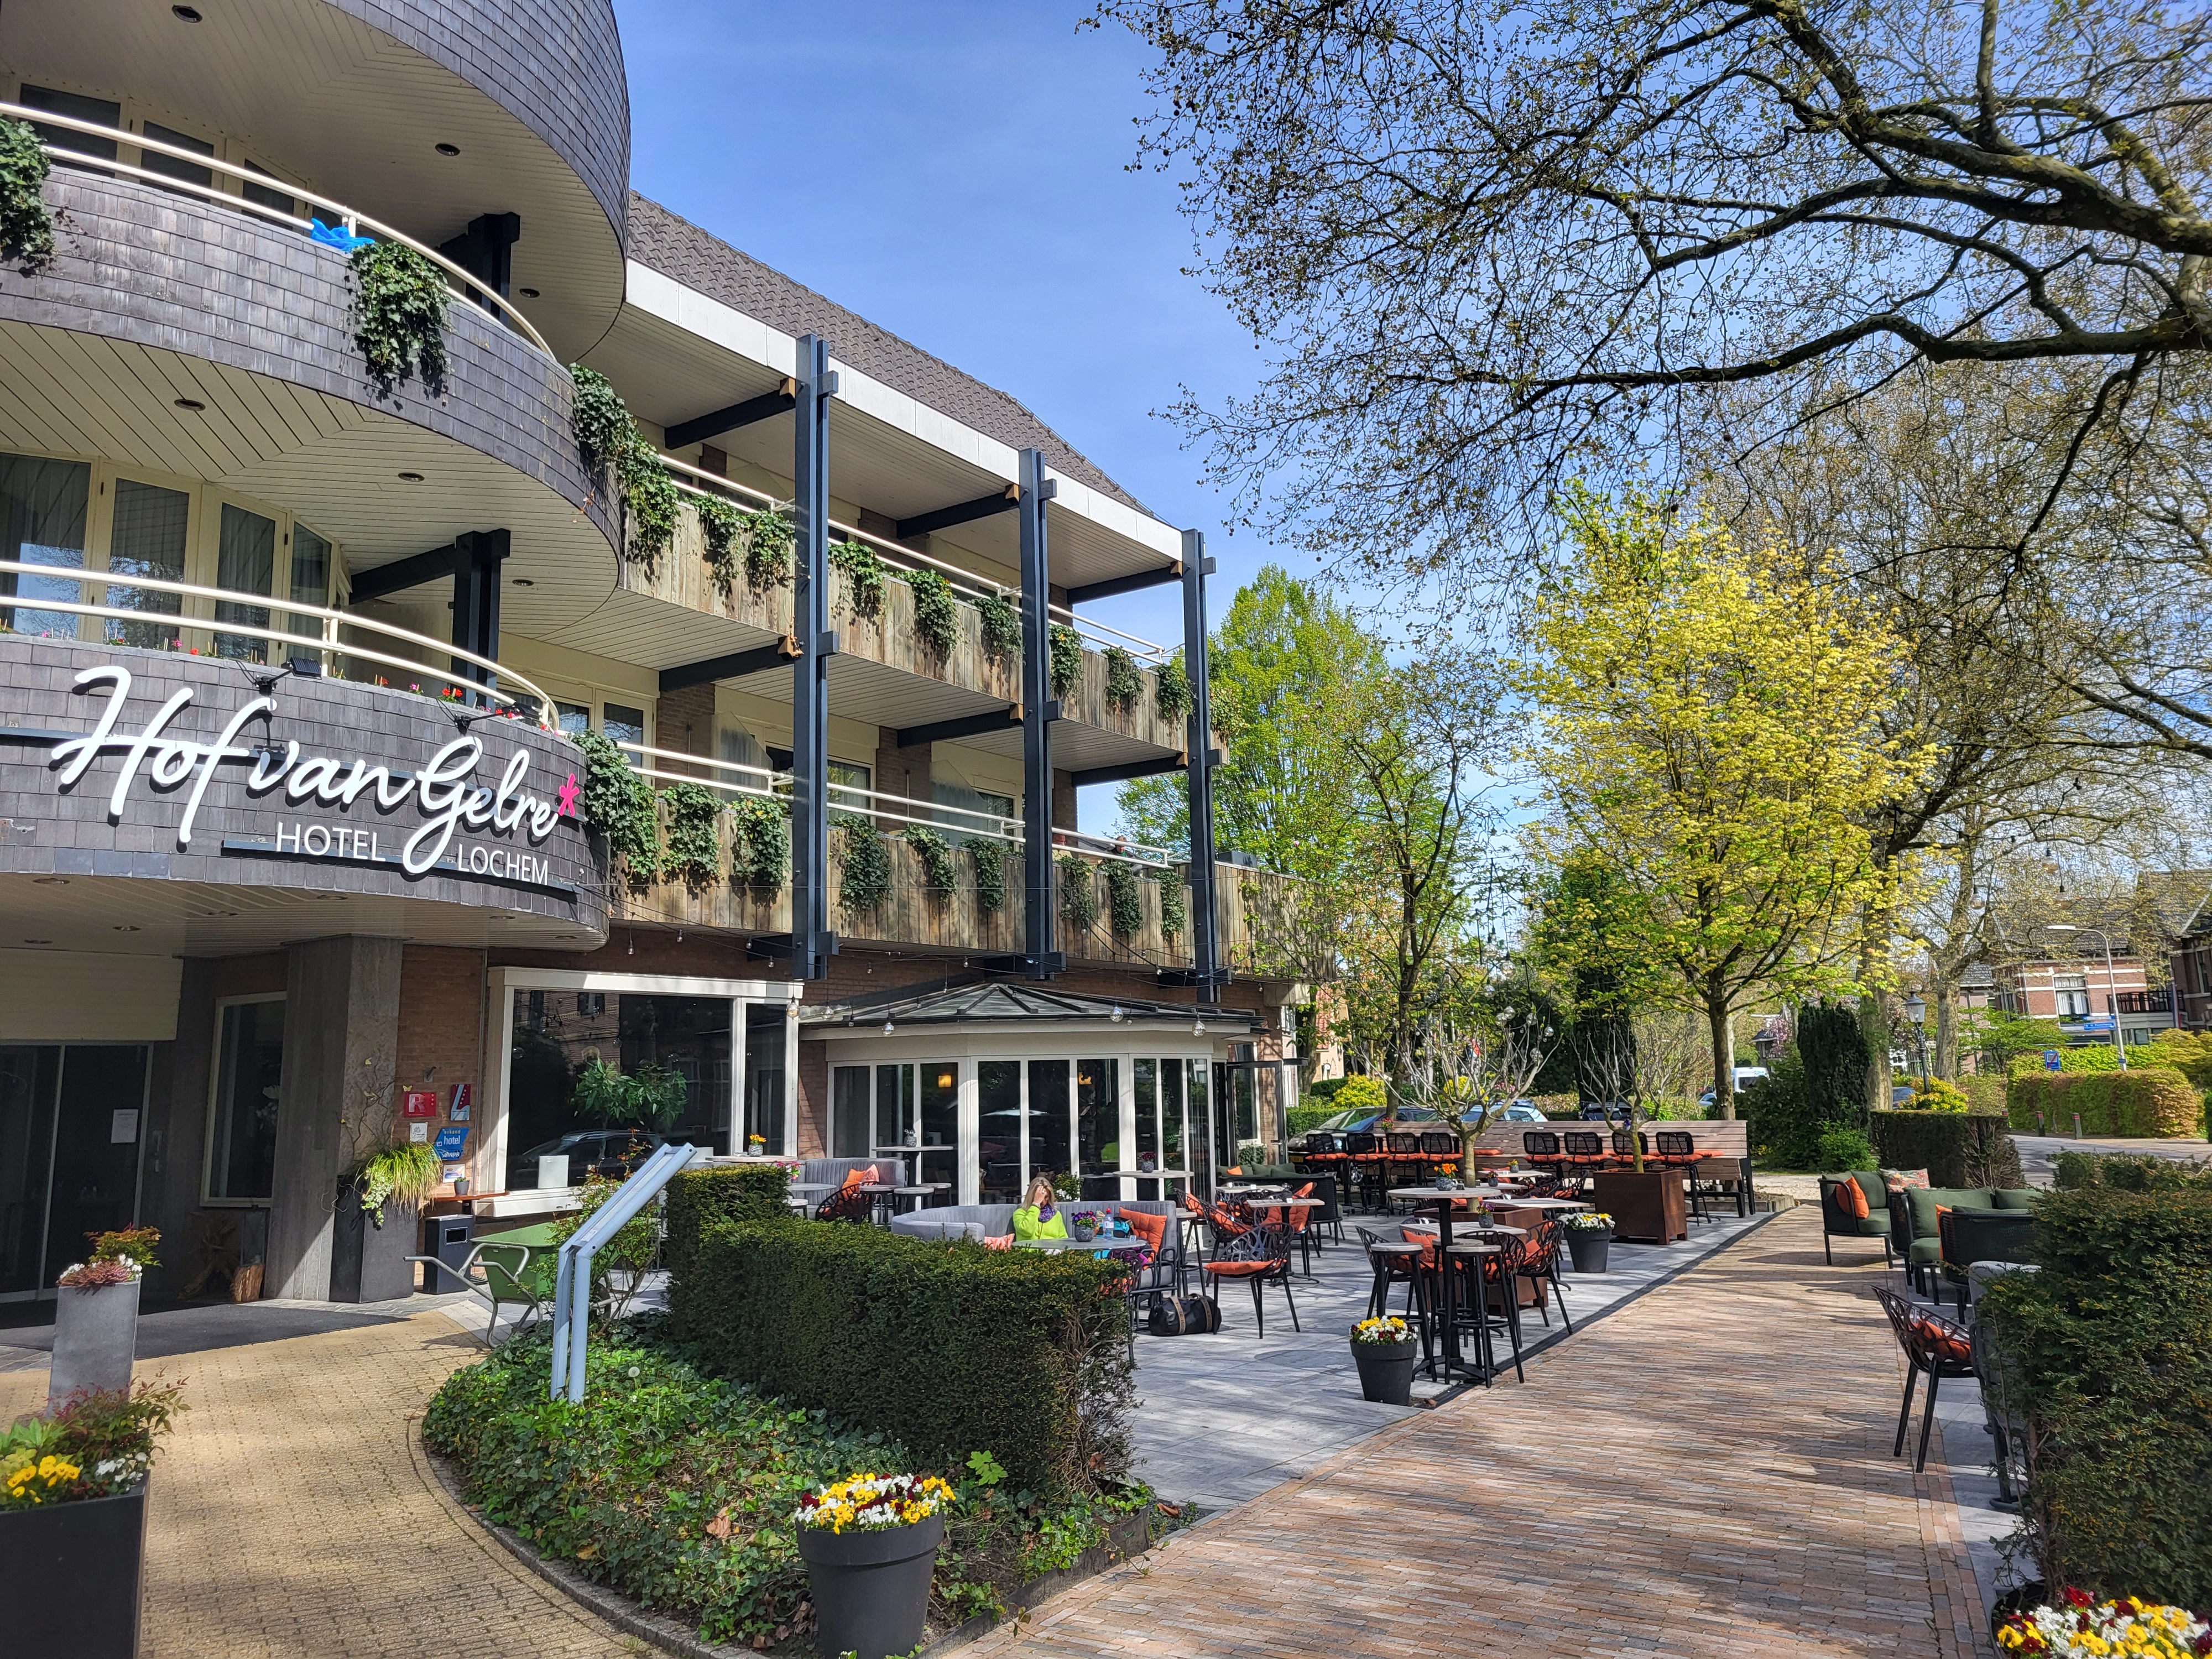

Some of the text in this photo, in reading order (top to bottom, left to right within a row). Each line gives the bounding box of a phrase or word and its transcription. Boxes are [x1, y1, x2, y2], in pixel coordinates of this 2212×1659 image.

[51, 665, 559, 874] Hof van Gelre
[276, 821, 548, 885] HOTEL LOCHEM
[409, 1093, 425, 1113] R
[444, 1135, 461, 1145] hotel
